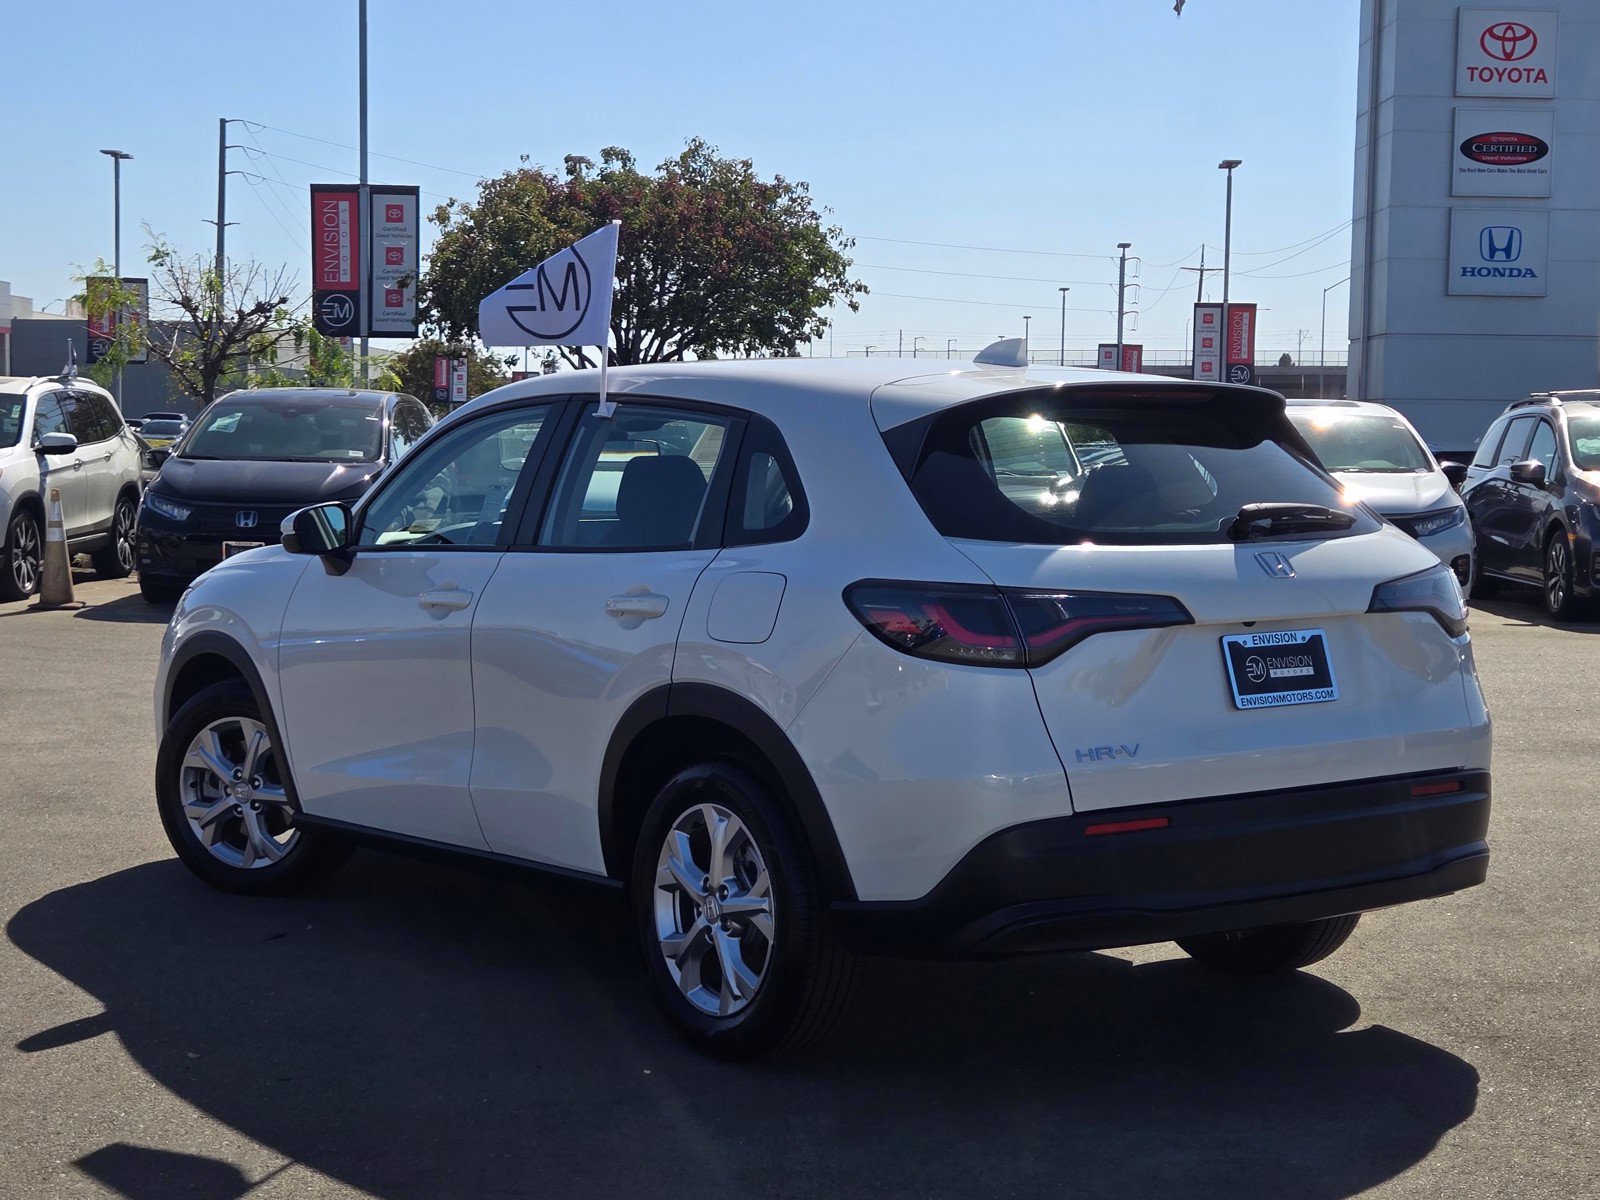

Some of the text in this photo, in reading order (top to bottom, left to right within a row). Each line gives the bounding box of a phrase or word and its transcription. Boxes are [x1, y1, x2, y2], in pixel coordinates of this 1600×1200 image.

[1467, 67, 1548, 83] TOYOTA
[1472, 142, 1538, 153] CERTIFIED
[323, 200, 339, 282] ENVISION
[341, 208, 349, 276] MOTORS
[1460, 266, 1538, 278] HONDA
[1232, 311, 1243, 359] ENVISION
[1252, 632, 1298, 645] ENVISION
[1266, 655, 1313, 669] ENVISION
[1240, 689, 1335, 707] ENVISIONMOTORS.COM
[1075, 743, 1140, 763] HR-V
